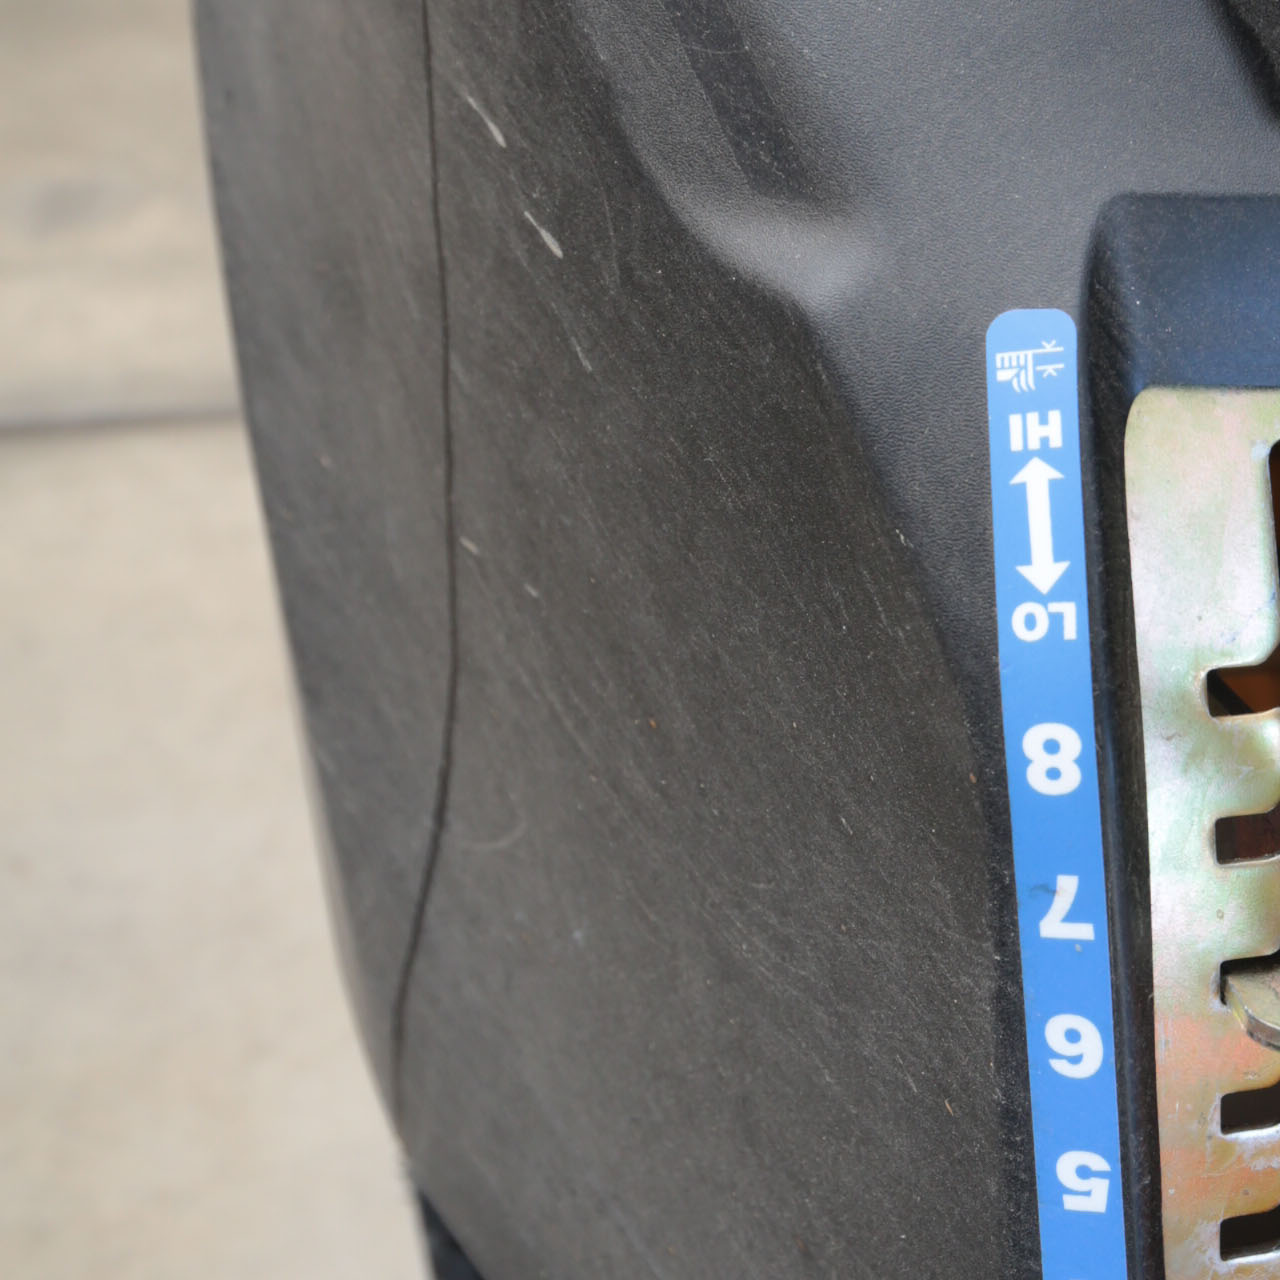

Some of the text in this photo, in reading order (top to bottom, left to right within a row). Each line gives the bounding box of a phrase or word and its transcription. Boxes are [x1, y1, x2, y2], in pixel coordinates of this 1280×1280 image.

[1007, 407, 1064, 454] HI
[1010, 600, 1078, 644] LO
[1021, 722, 1083, 797] 8
[1039, 874, 1095, 941] 7
[1044, 1013, 1104, 1079] 6
[1055, 1150, 1111, 1214] 5
